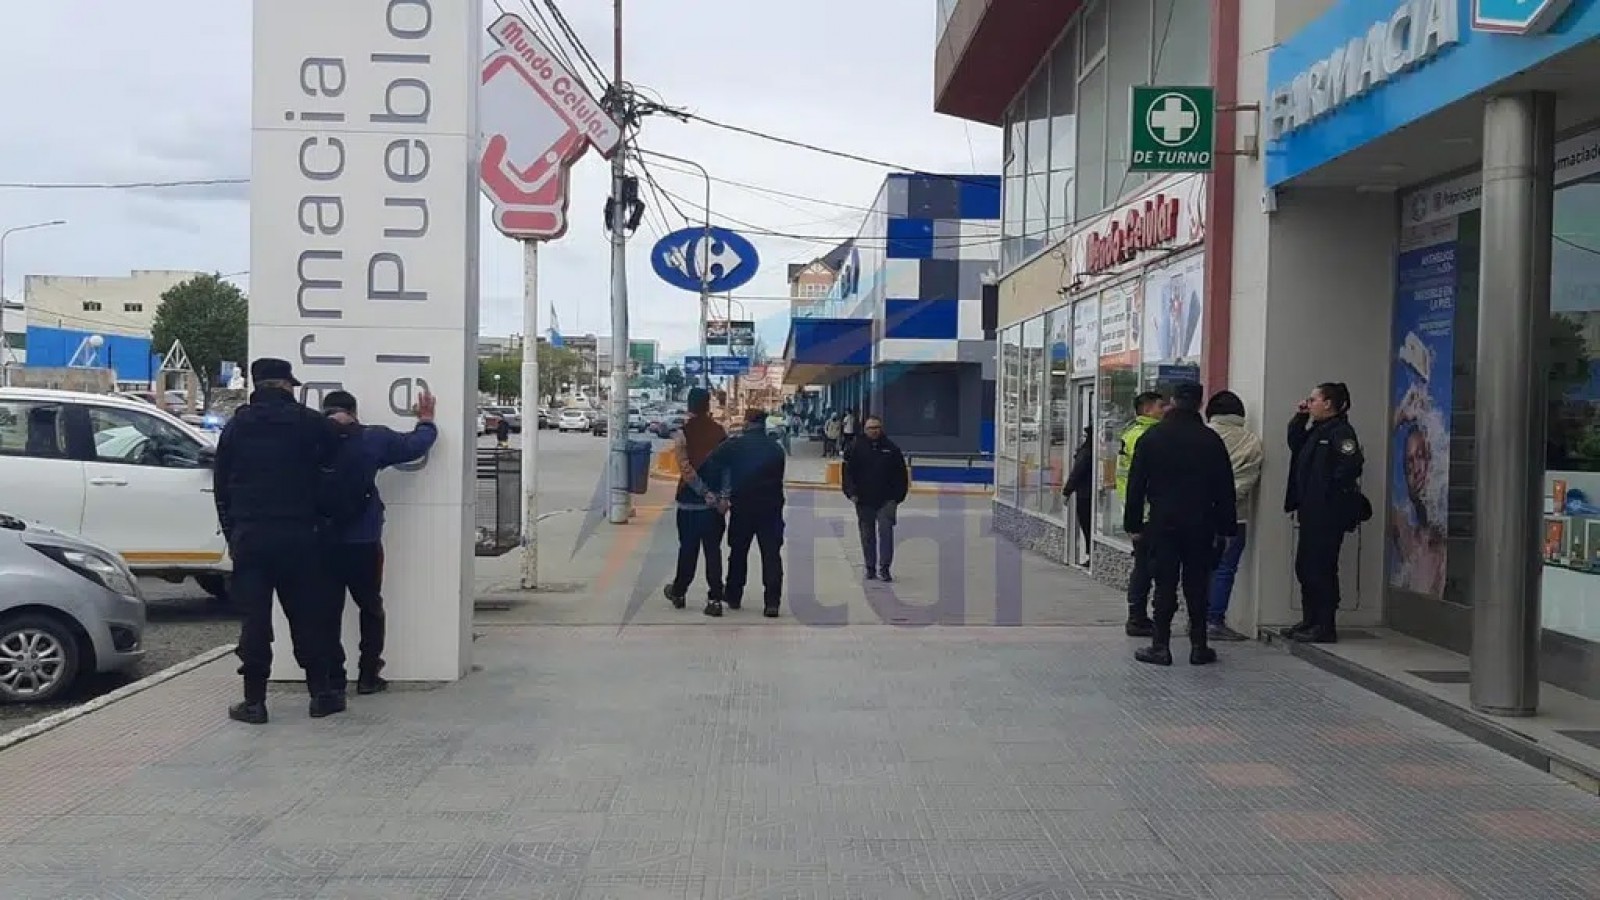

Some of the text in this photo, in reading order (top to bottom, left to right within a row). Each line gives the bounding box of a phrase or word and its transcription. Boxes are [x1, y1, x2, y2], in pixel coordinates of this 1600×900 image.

[500, 21, 609, 139] Mundo Celular
[1269, 0, 1459, 141] FARMACIA
[367, 0, 432, 300] Pueblo
[1133, 150, 1210, 165] DE TURNO
[284, 56, 347, 410] armacia
